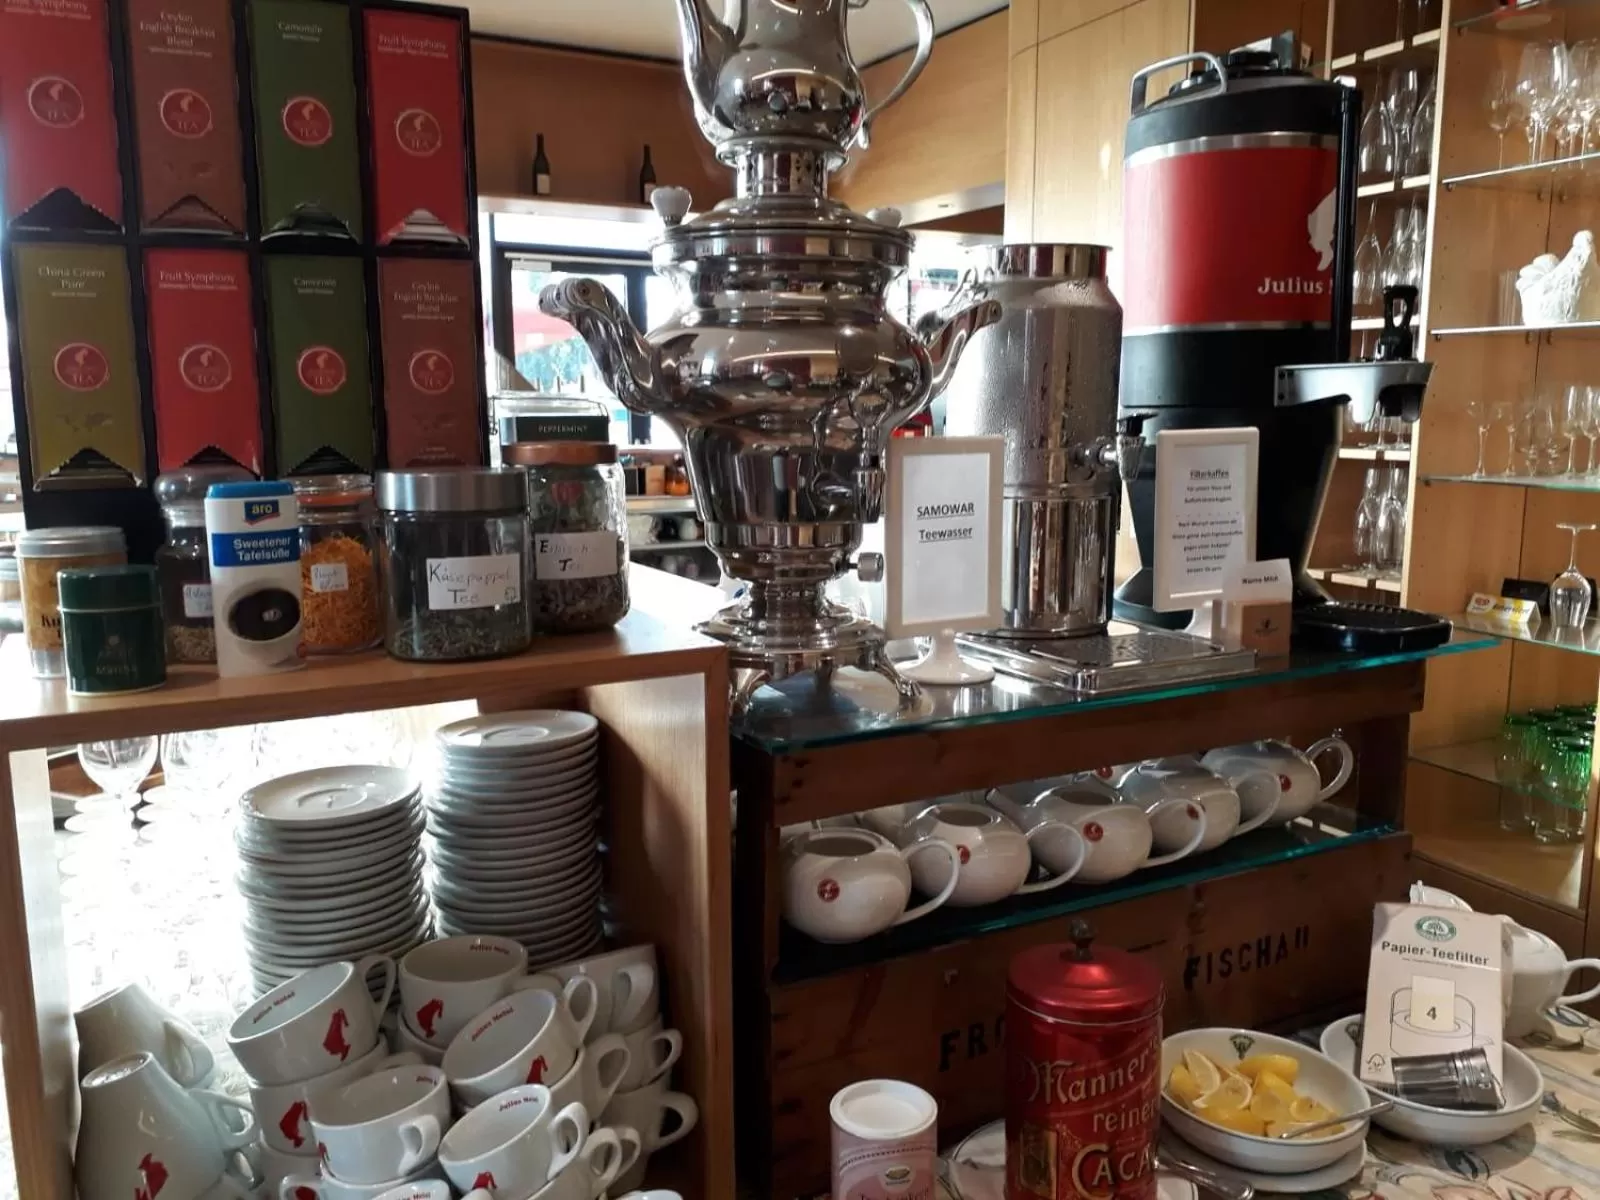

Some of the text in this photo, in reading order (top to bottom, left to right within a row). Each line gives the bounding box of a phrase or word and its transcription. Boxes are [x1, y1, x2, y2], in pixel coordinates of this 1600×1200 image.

[1257, 276, 1324, 295] Julius
[538, 423, 588, 433] PEPPERMINT
[251, 503, 273, 514] aro
[917, 502, 975, 517] SAMOWAR
[919, 526, 973, 541] Teewasser
[233, 536, 291, 549] Sweetener
[1381, 940, 1490, 966] Papier-Teefilter
[1426, 1006, 1438, 1021] 4
